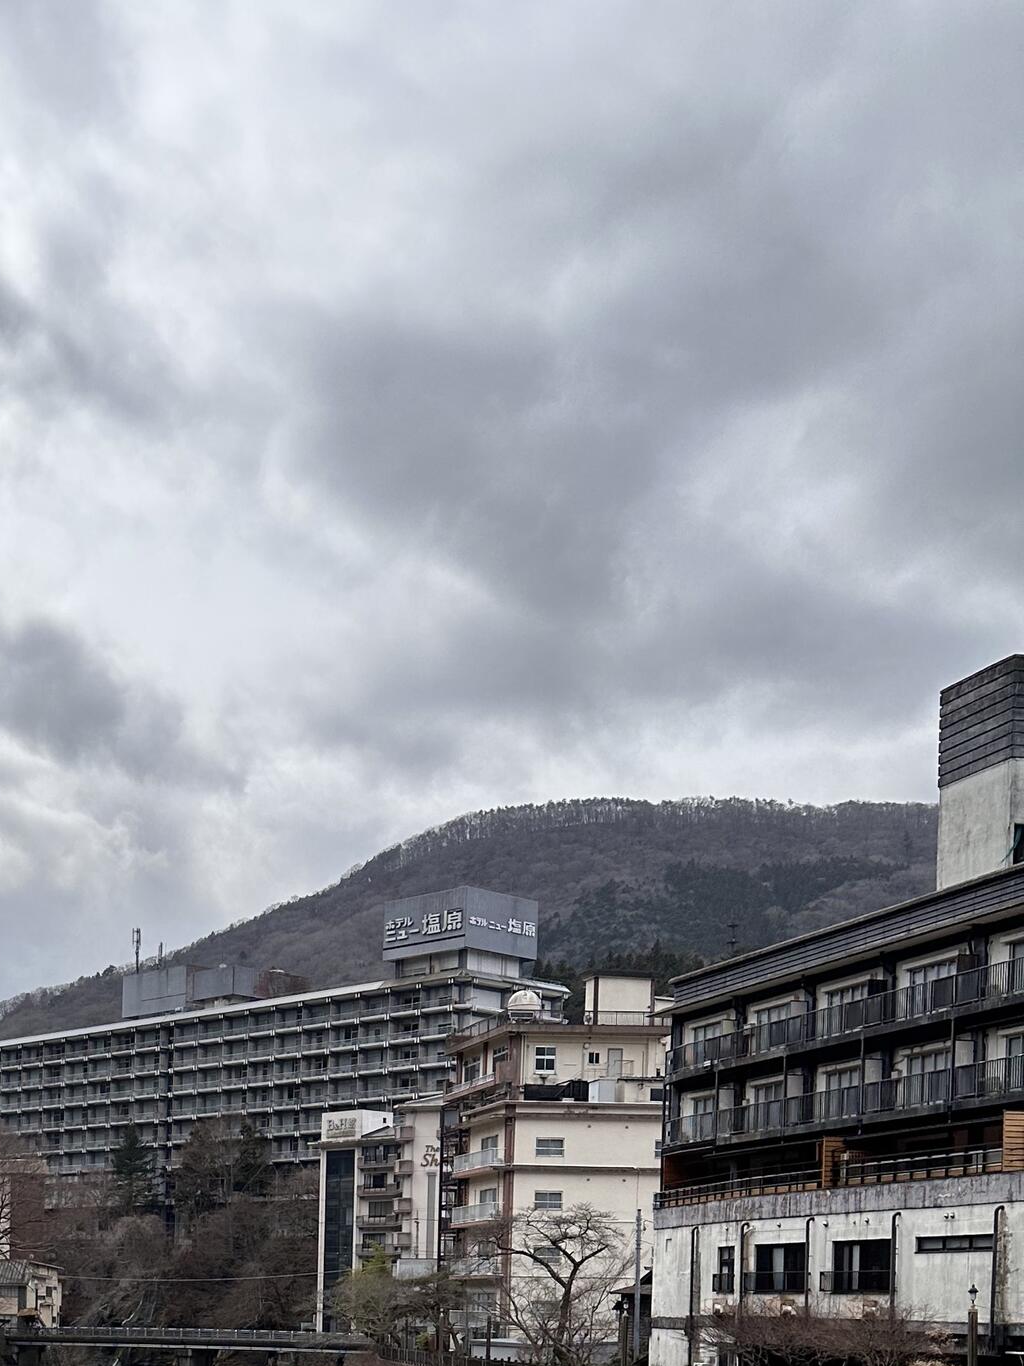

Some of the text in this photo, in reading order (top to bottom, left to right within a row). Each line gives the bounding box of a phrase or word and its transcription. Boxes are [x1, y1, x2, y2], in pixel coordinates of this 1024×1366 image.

[385, 916, 413, 929] ホテル
[422, 908, 463, 935] 塩原
[425, 1144, 440, 1153] The
[420, 1153, 441, 1168] Sh
